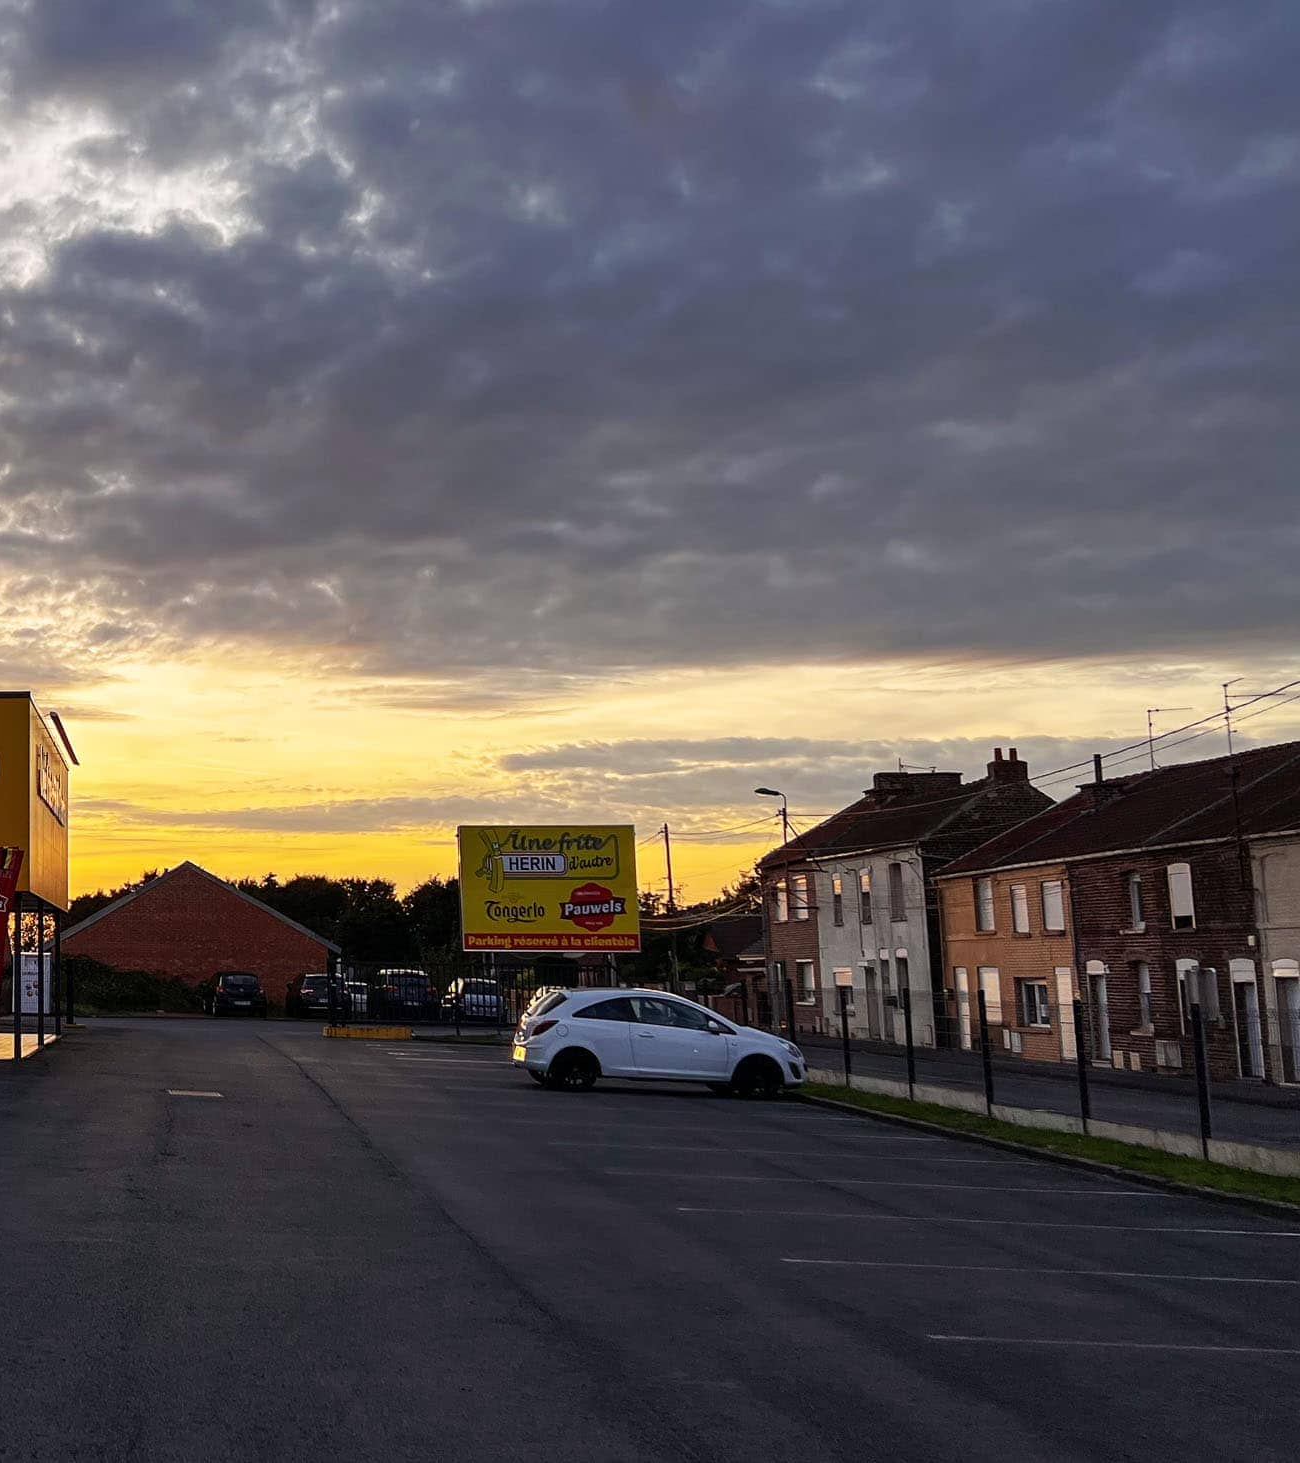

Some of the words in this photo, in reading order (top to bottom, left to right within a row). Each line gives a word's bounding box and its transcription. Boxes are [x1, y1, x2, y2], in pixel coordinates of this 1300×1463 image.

[507, 829, 556, 850] Une
[557, 832, 604, 853] frite
[508, 856, 556, 871] HERIN
[484, 900, 546, 923] Tongerlo
[564, 899, 622, 916] Pauwels
[468, 935, 512, 949] Parking
[513, 935, 559, 947] réservé
[561, 935, 569, 947] à
[570, 935, 582, 947] la
[584, 935, 636, 947] clientèle
